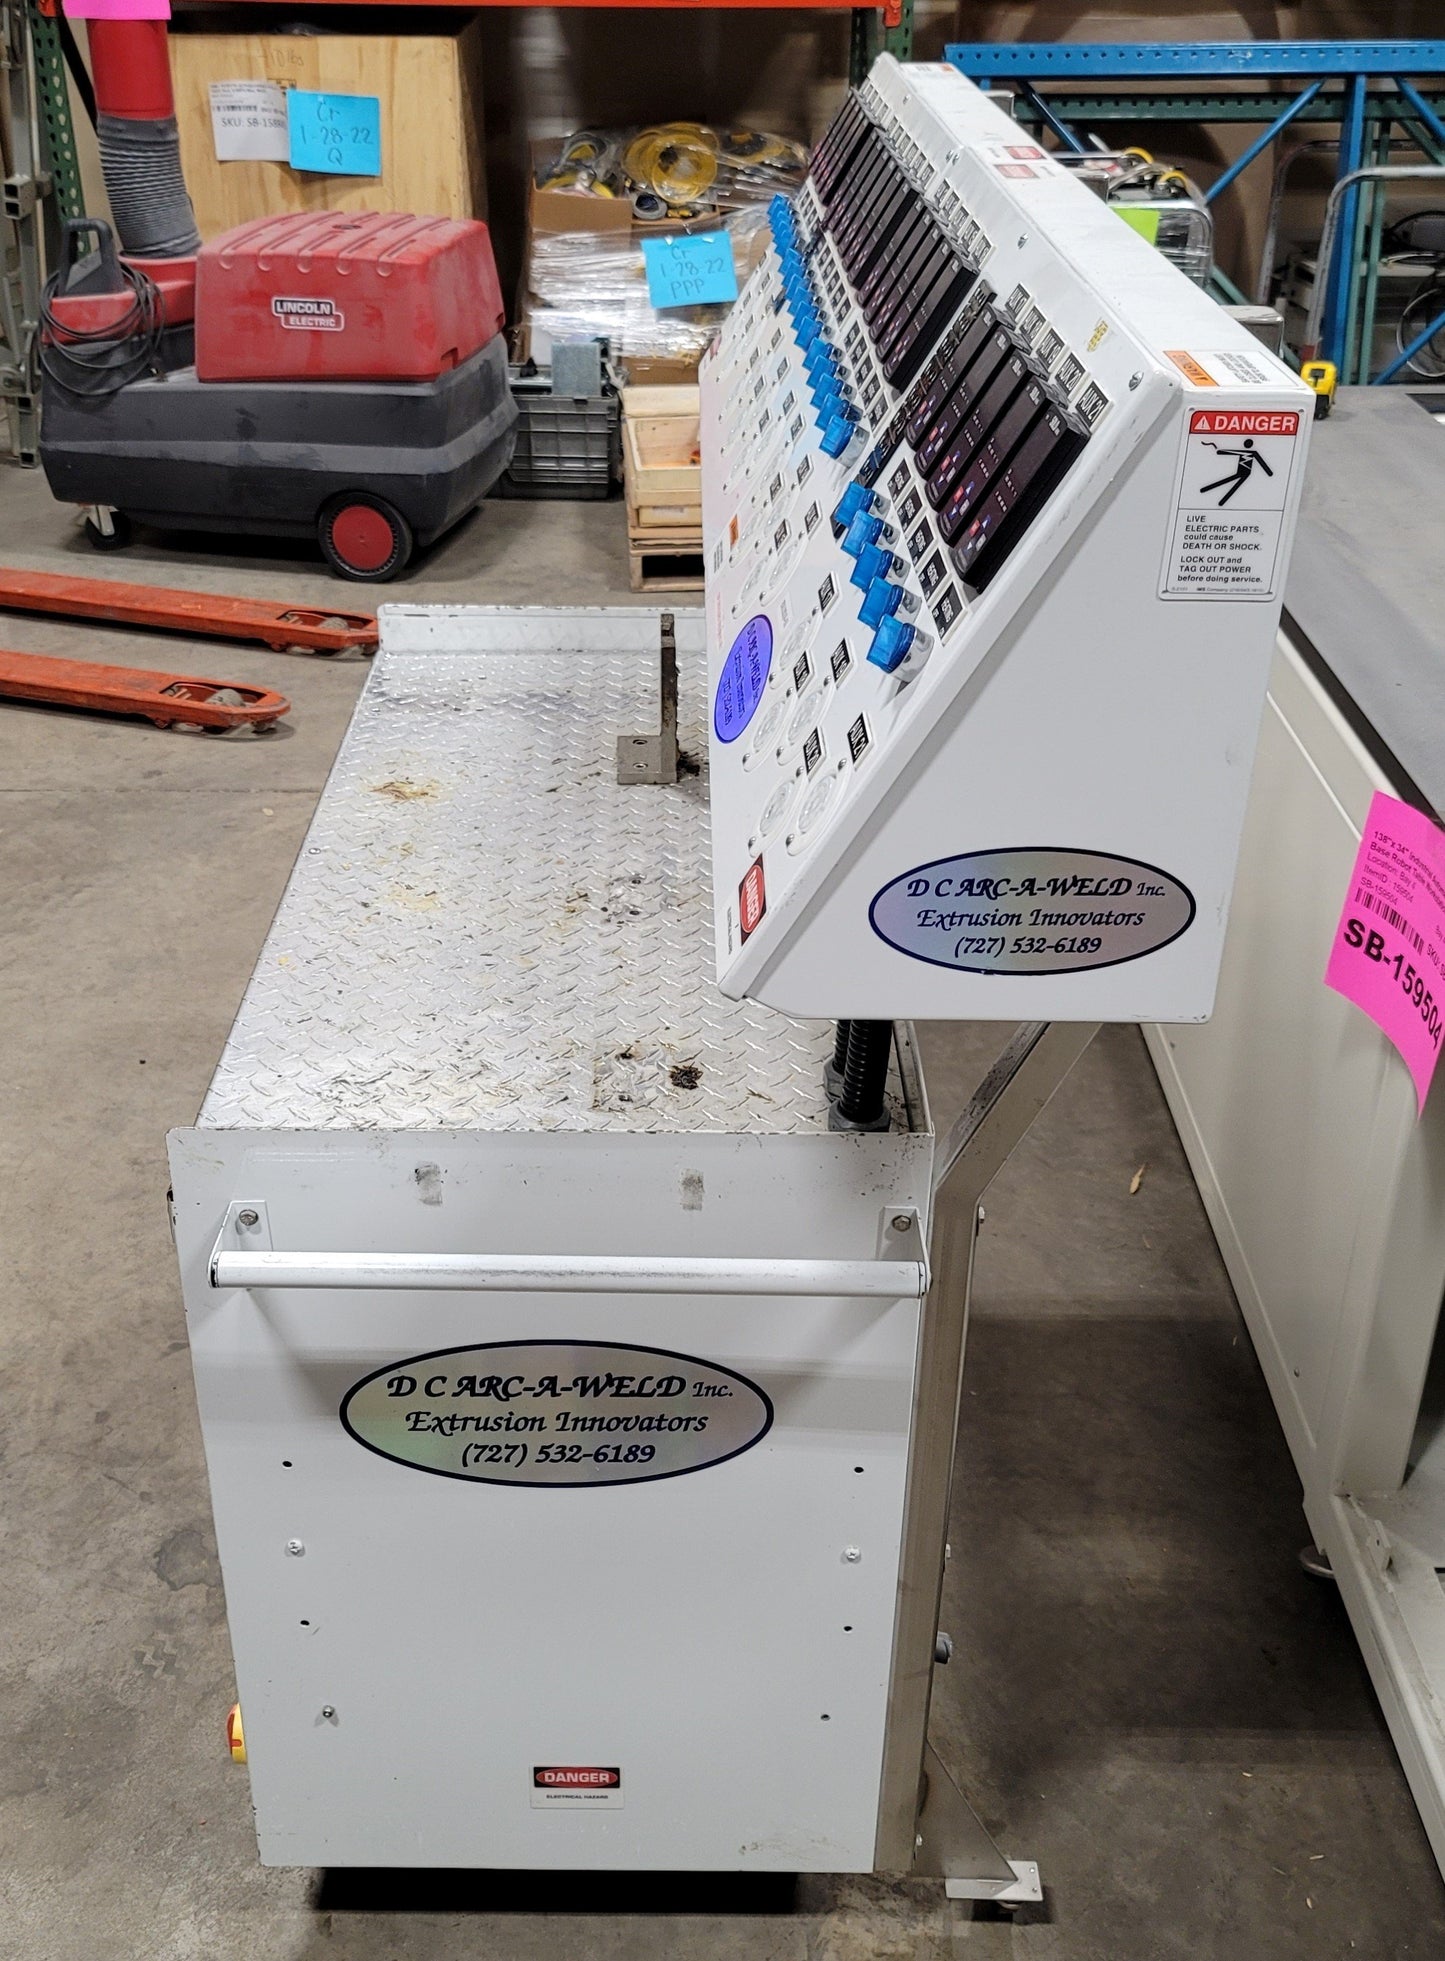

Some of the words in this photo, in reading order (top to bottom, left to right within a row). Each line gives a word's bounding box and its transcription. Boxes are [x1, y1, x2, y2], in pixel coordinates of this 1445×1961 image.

[300, 126, 374, 144] 1-28-22
[276, 301, 331, 315] LINCOLN
[289, 316, 336, 327] ELECTRIC
[1079, 388, 1100, 415] AUX
[1088, 400, 1105, 422] 21
[1214, 416, 1295, 431] DANGER
[1370, 841, 1390, 858] Base
[1391, 853, 1412, 872] Robot
[746, 868, 759, 928] DANGER
[907, 878, 930, 897] D
[934, 878, 951, 897] C
[954, 875, 1132, 900] ARC-A-WELD
[1136, 883, 1166, 897] Inc.
[917, 909, 1022, 931] Extrusion
[1028, 908, 1145, 927] Innovators
[954, 936, 1005, 958] (727)
[1010, 937, 1102, 954] 532-6189
[1344, 918, 1442, 1050] SB-159504
[387, 1375, 417, 1397] D
[424, 1375, 447, 1397] C
[451, 1372, 686, 1401] ARC-A-WELD
[692, 1382, 733, 1397] Inc.
[405, 1411, 547, 1436] Extrusion
[555, 1411, 709, 1432] Innovators
[461, 1443, 528, 1468] (727)
[535, 1443, 656, 1463] 532-6189
[544, 1772, 610, 1783] DANGER
